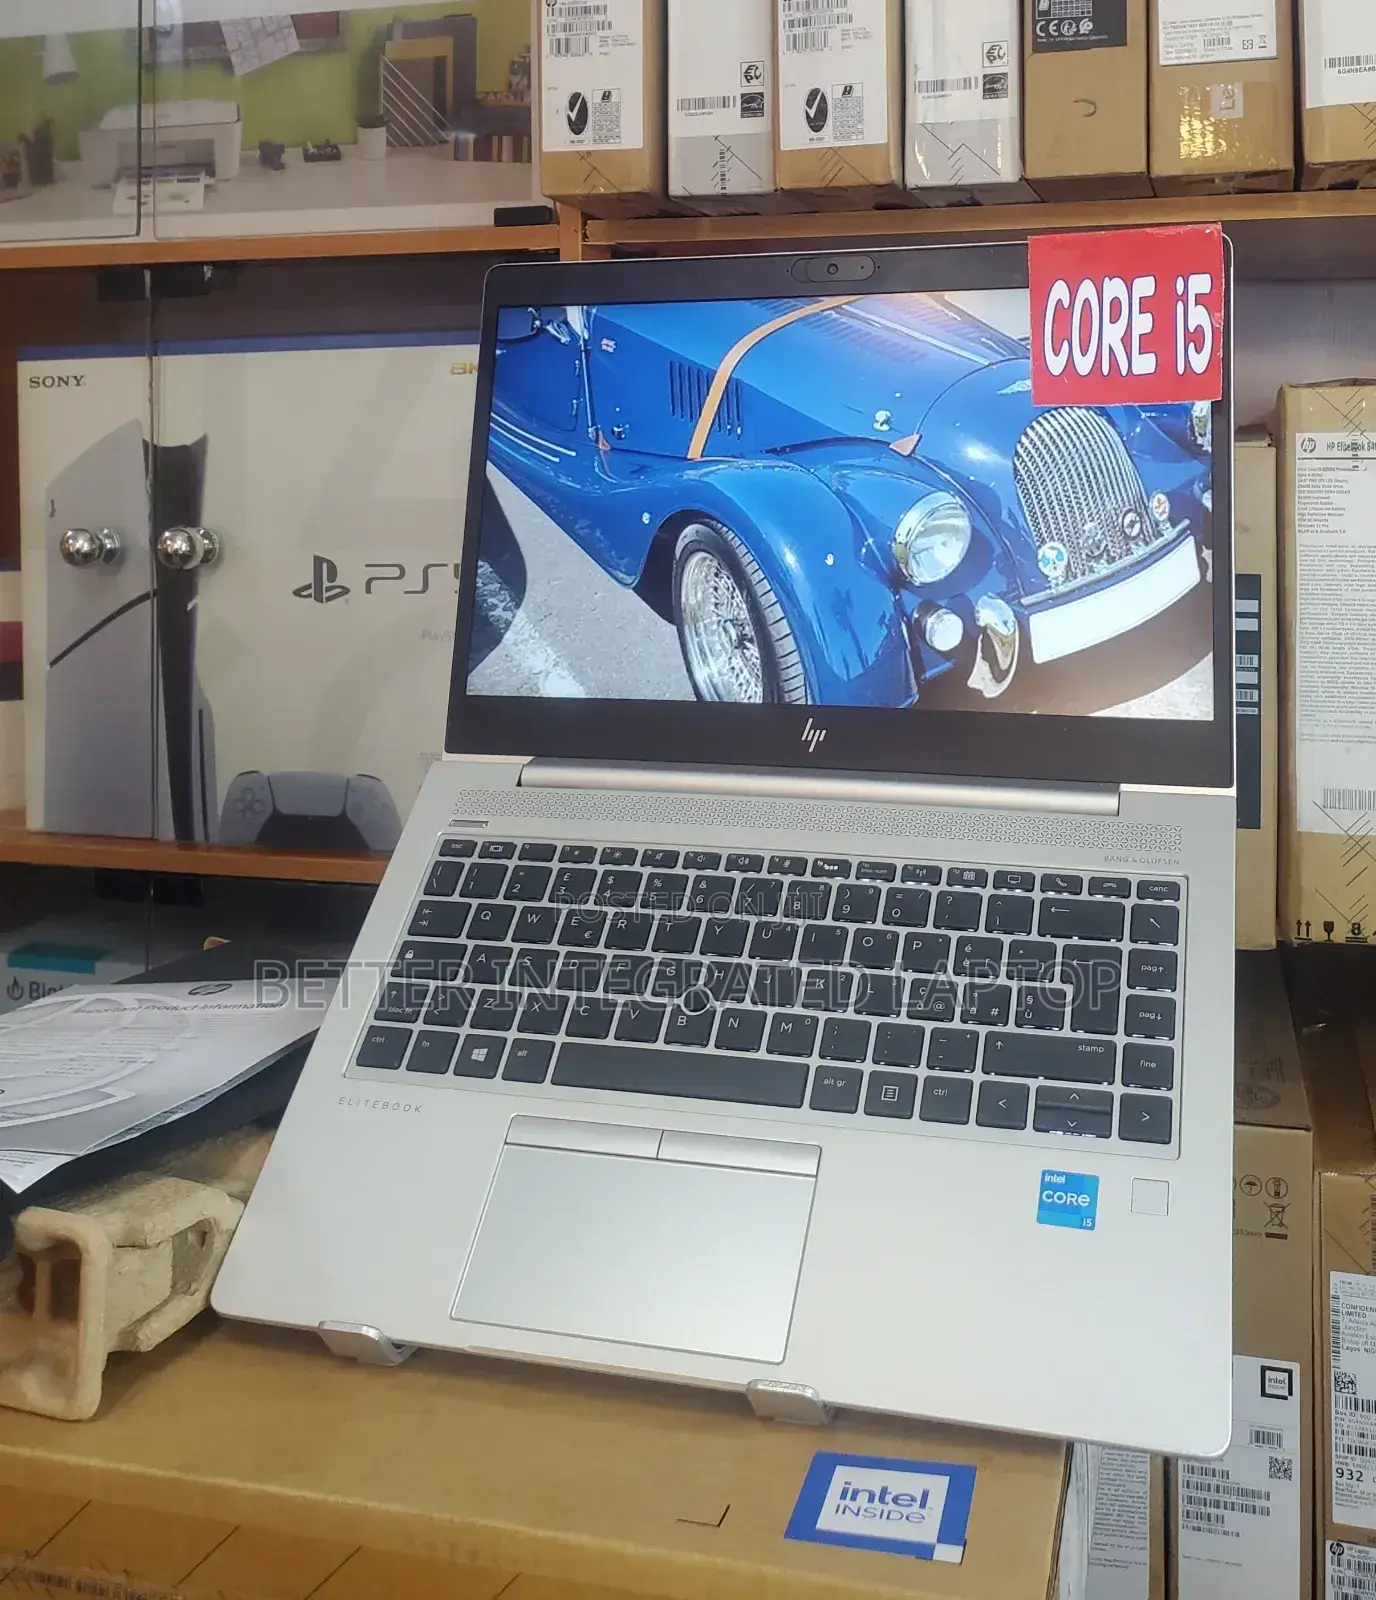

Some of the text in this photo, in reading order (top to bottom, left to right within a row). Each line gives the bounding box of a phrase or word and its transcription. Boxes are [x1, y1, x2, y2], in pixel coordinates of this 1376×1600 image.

[1043, 272, 1213, 377] CORE i5
[28, 374, 84, 389] SONY
[1326, 442, 1336, 451] HP
[1104, 854, 1129, 863] BANG
[1139, 857, 1180, 866] OLUFSEN
[607, 875, 614, 885] $
[653, 879, 663, 888] %
[699, 881, 707, 889] &
[512, 884, 521, 893] 2
[557, 887, 566, 895] 3
[696, 894, 704, 904] 6
[793, 901, 801, 910] 8
[842, 905, 851, 914] 9
[481, 910, 492, 921] Q
[527, 914, 541, 924] W
[570, 916, 581, 926] E
[617, 919, 627, 929] R
[666, 922, 673, 932] T
[714, 925, 724, 935] Y
[584, 930, 593, 939] €
[762, 929, 772, 939] U
[913, 941, 922, 951] P
[476, 953, 487, 963] A
[524, 956, 533, 966] S
[569, 960, 579, 969] D
[616, 962, 626, 972] F
[666, 966, 676, 976] G
[714, 970, 724, 980] H
[764, 974, 772, 984] J
[815, 978, 826, 989] K
[483, 998, 494, 1008] Z
[1026, 995, 1034, 1005] §
[531, 1002, 542, 1012] X
[580, 1006, 590, 1016] C
[932, 1001, 946, 1012] @
[990, 1007, 1000, 1016] #
[630, 1009, 640, 1019] V
[677, 1015, 687, 1026] B
[728, 1017, 739, 1029] N
[780, 1022, 793, 1033] M
[372, 1036, 385, 1044] ctrl
[1078, 1044, 1105, 1053] stamp
[1139, 1059, 1157, 1069] fine
[823, 1077, 847, 1087] alt gr
[933, 1088, 948, 1096] ctrl
[338, 1096, 423, 1113] ELITEBOOK
[1044, 1172, 1066, 1184] intel
[1341, 1309, 1367, 1319] LIMITED
[1335, 1467, 1364, 1482] 932
[838, 1480, 930, 1510] intel
